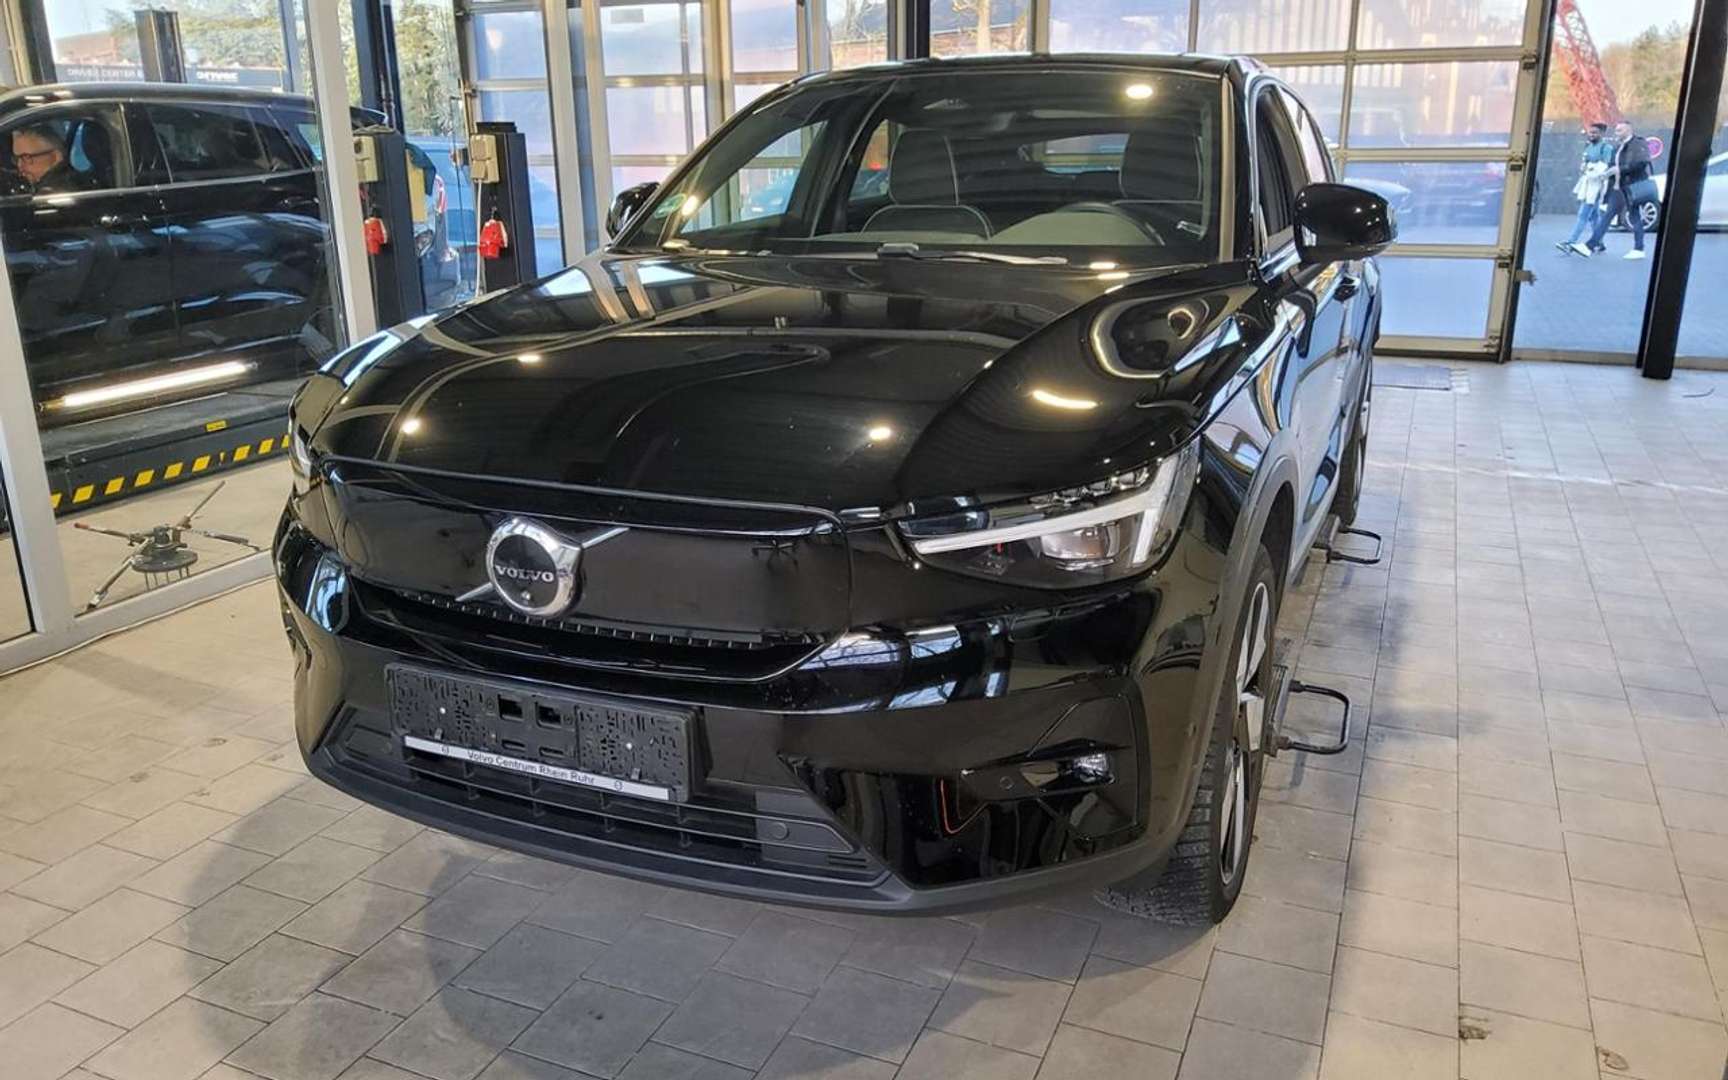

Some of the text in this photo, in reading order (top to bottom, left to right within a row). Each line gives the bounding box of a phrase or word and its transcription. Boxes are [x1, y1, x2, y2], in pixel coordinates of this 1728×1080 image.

[494, 564, 555, 582] VOLVO
[467, 750, 594, 784] Volvo Centrum Rhein Ruhr
